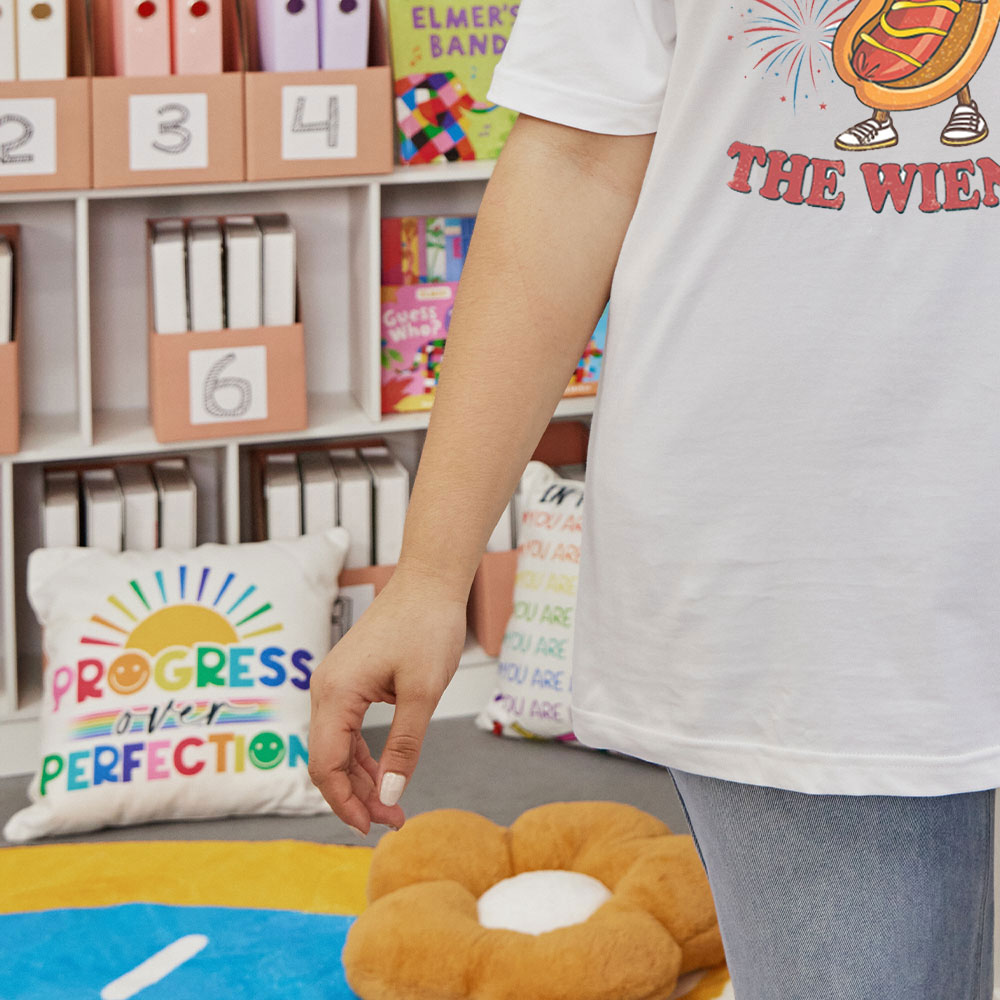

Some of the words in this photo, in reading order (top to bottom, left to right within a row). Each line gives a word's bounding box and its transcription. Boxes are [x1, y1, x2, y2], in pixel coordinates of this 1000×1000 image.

[430, 34, 508, 59] BAND
[0, 113, 35, 163] 2
[152, 103, 192, 154] 3
[290, 95, 340, 148] 4
[726, 141, 847, 212] THE
[383, 305, 440, 328] Guess
[388, 319, 443, 343] Who?
[203, 352, 253, 418] 6
[541, 603, 575, 629] ARE
[535, 634, 567, 660] ARE
[52, 646, 314, 712] PROGRESS
[531, 664, 564, 693] ARE
[115, 699, 228, 734] over
[40, 731, 310, 796] PERFECTION
